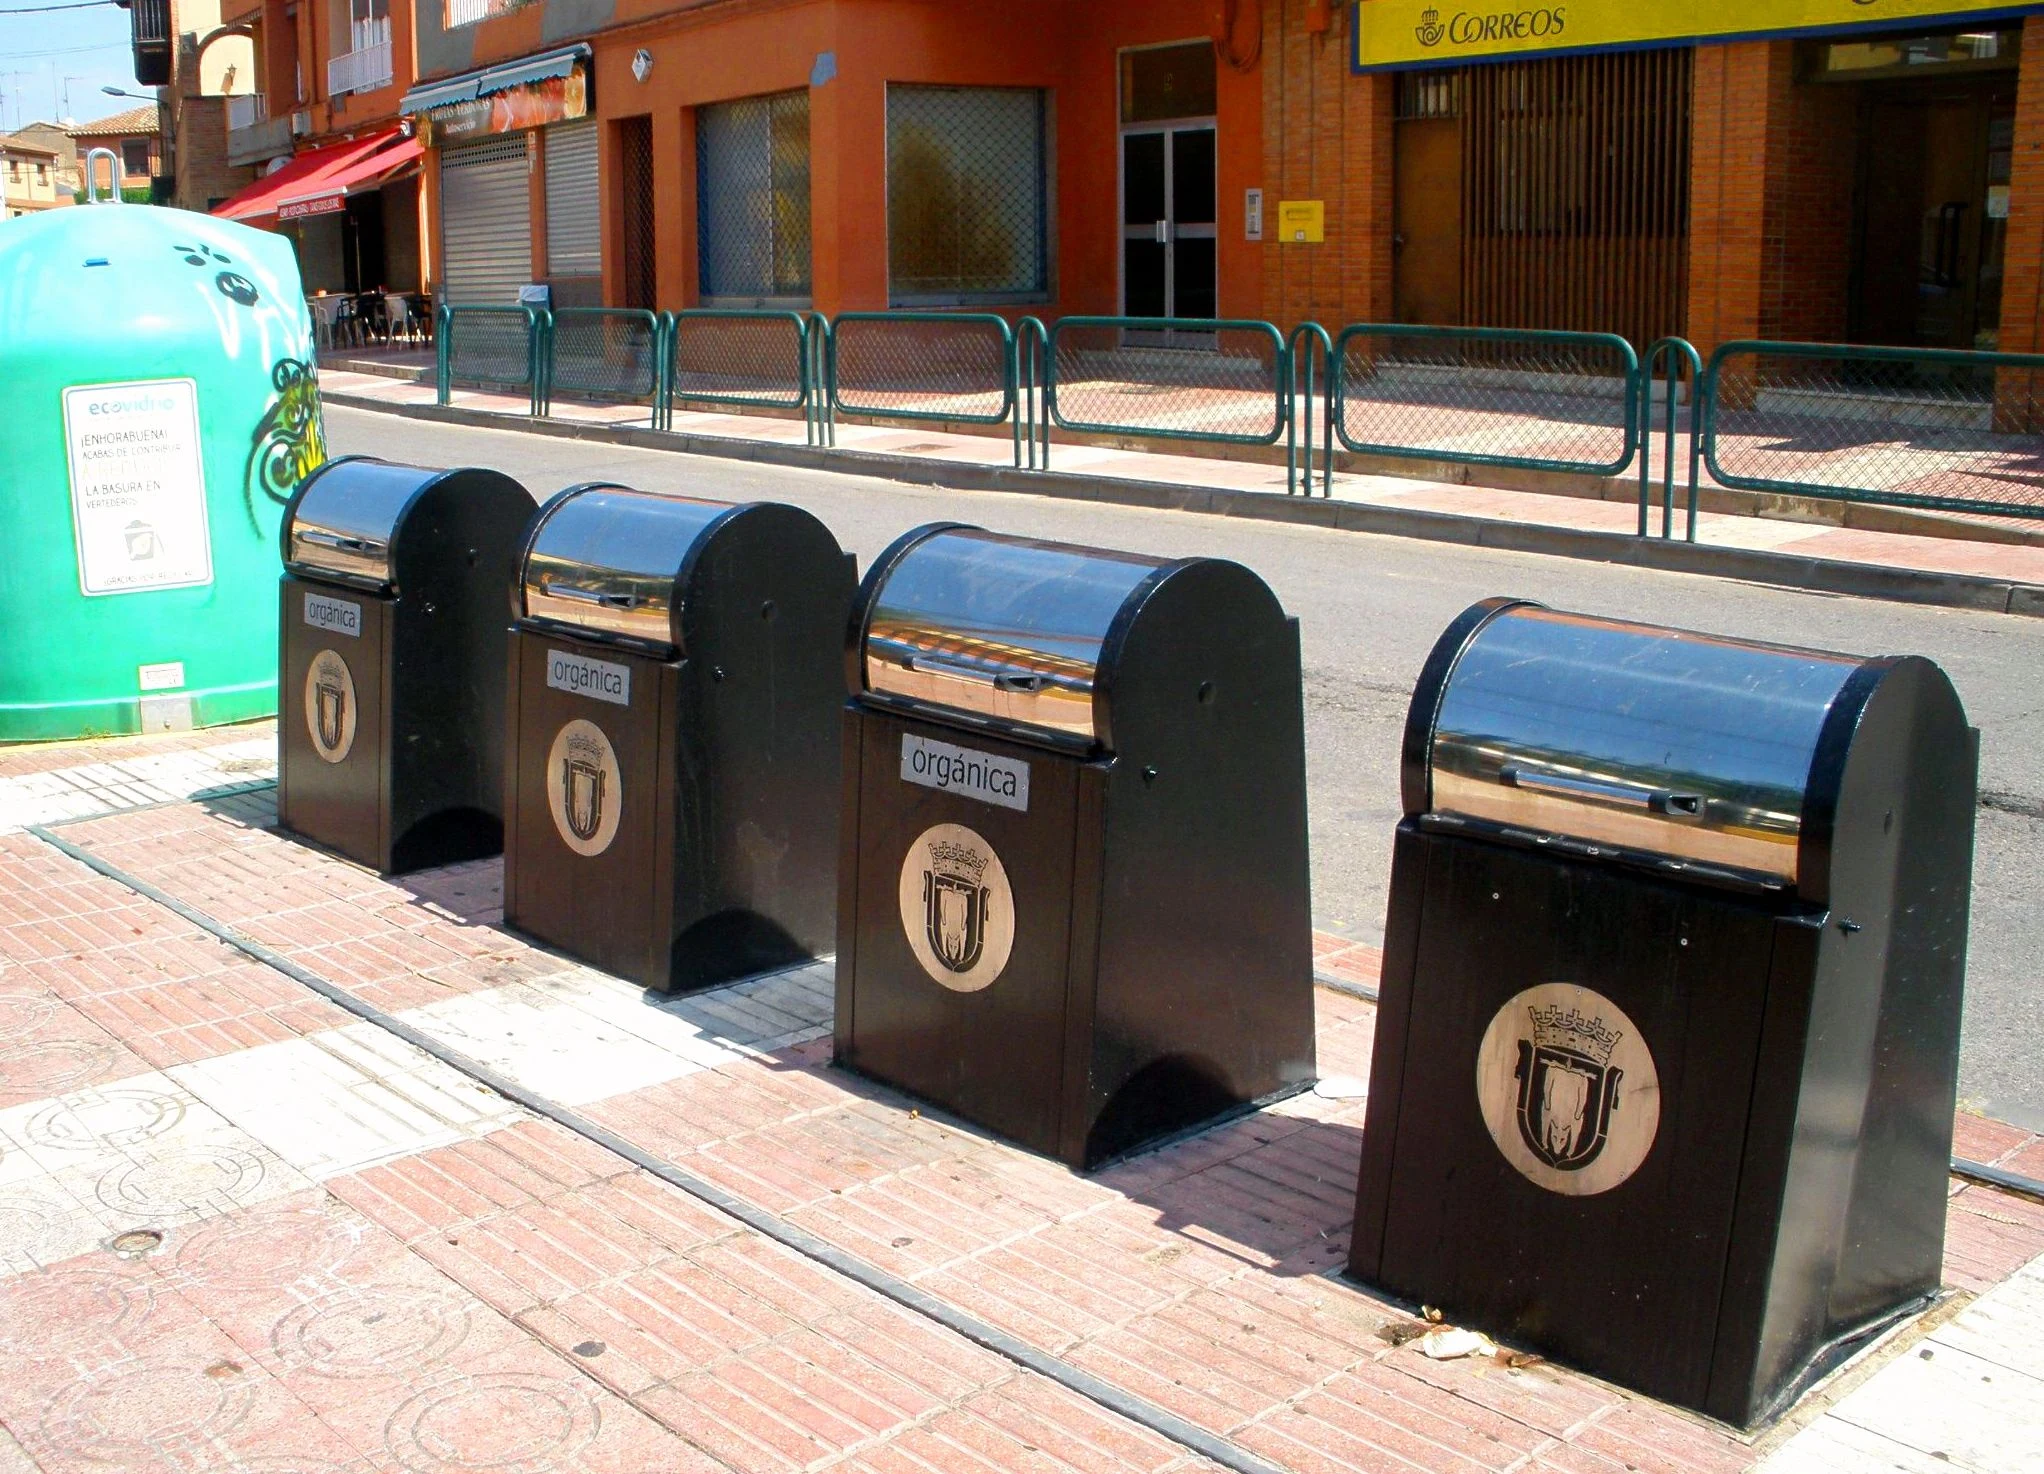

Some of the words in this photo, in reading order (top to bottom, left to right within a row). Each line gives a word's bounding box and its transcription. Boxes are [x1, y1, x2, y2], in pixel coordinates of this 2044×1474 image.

[1450, 7, 1566, 44] CORREOS
[81, 429, 168, 448] ¡ENHORABUENA!
[83, 448, 114, 460] ACABAS
[117, 447, 128, 457] DE
[86, 485, 99, 497] LA
[102, 481, 143, 495] BASURA
[146, 480, 161, 491] EN
[309, 602, 356, 628] orgánica
[554, 660, 622, 695] orgánica
[912, 749, 1017, 798] orgánica
